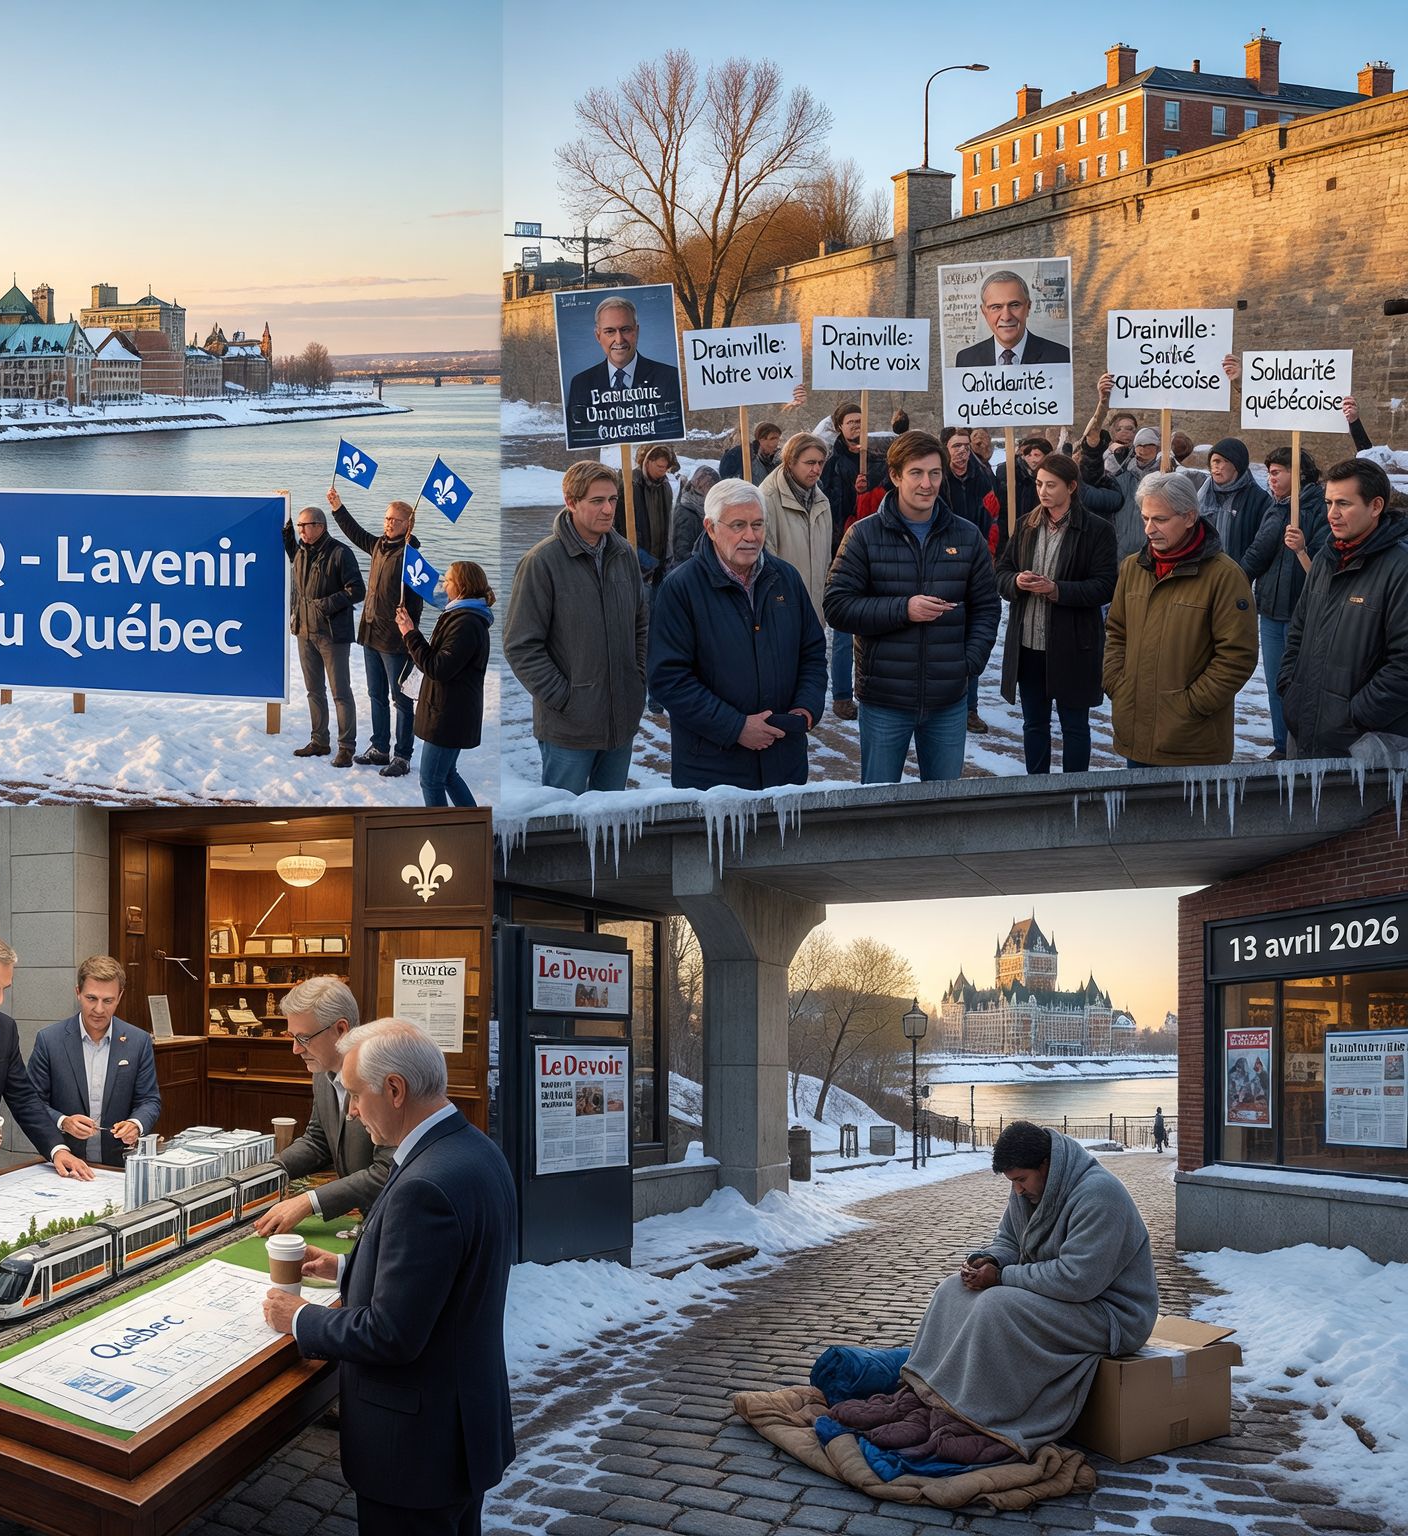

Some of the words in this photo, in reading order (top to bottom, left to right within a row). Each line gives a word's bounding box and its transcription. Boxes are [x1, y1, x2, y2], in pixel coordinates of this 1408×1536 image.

[822, 324, 913, 347] Drainville:
[1117, 315, 1216, 340] Drainville:
[691, 332, 787, 361] Drainville:
[830, 350, 880, 371] Notre
[886, 353, 921, 371] voix
[701, 363, 752, 386] Notre
[757, 361, 794, 380] voix
[1115, 368, 1221, 399] québécoise
[1250, 356, 1336, 382] Solidarité
[1245, 387, 1344, 418] québécoise
[20, 554, 41, 566] -
[57, 535, 257, 588] L'avenir
[39, 601, 244, 659] Québec
[1229, 935, 1258, 962] 13
[1264, 924, 1321, 959] avril
[1328, 915, 1400, 951] 2026
[538, 955, 561, 979] Le
[563, 959, 623, 984] Devoir
[540, 1054, 562, 1076] Le
